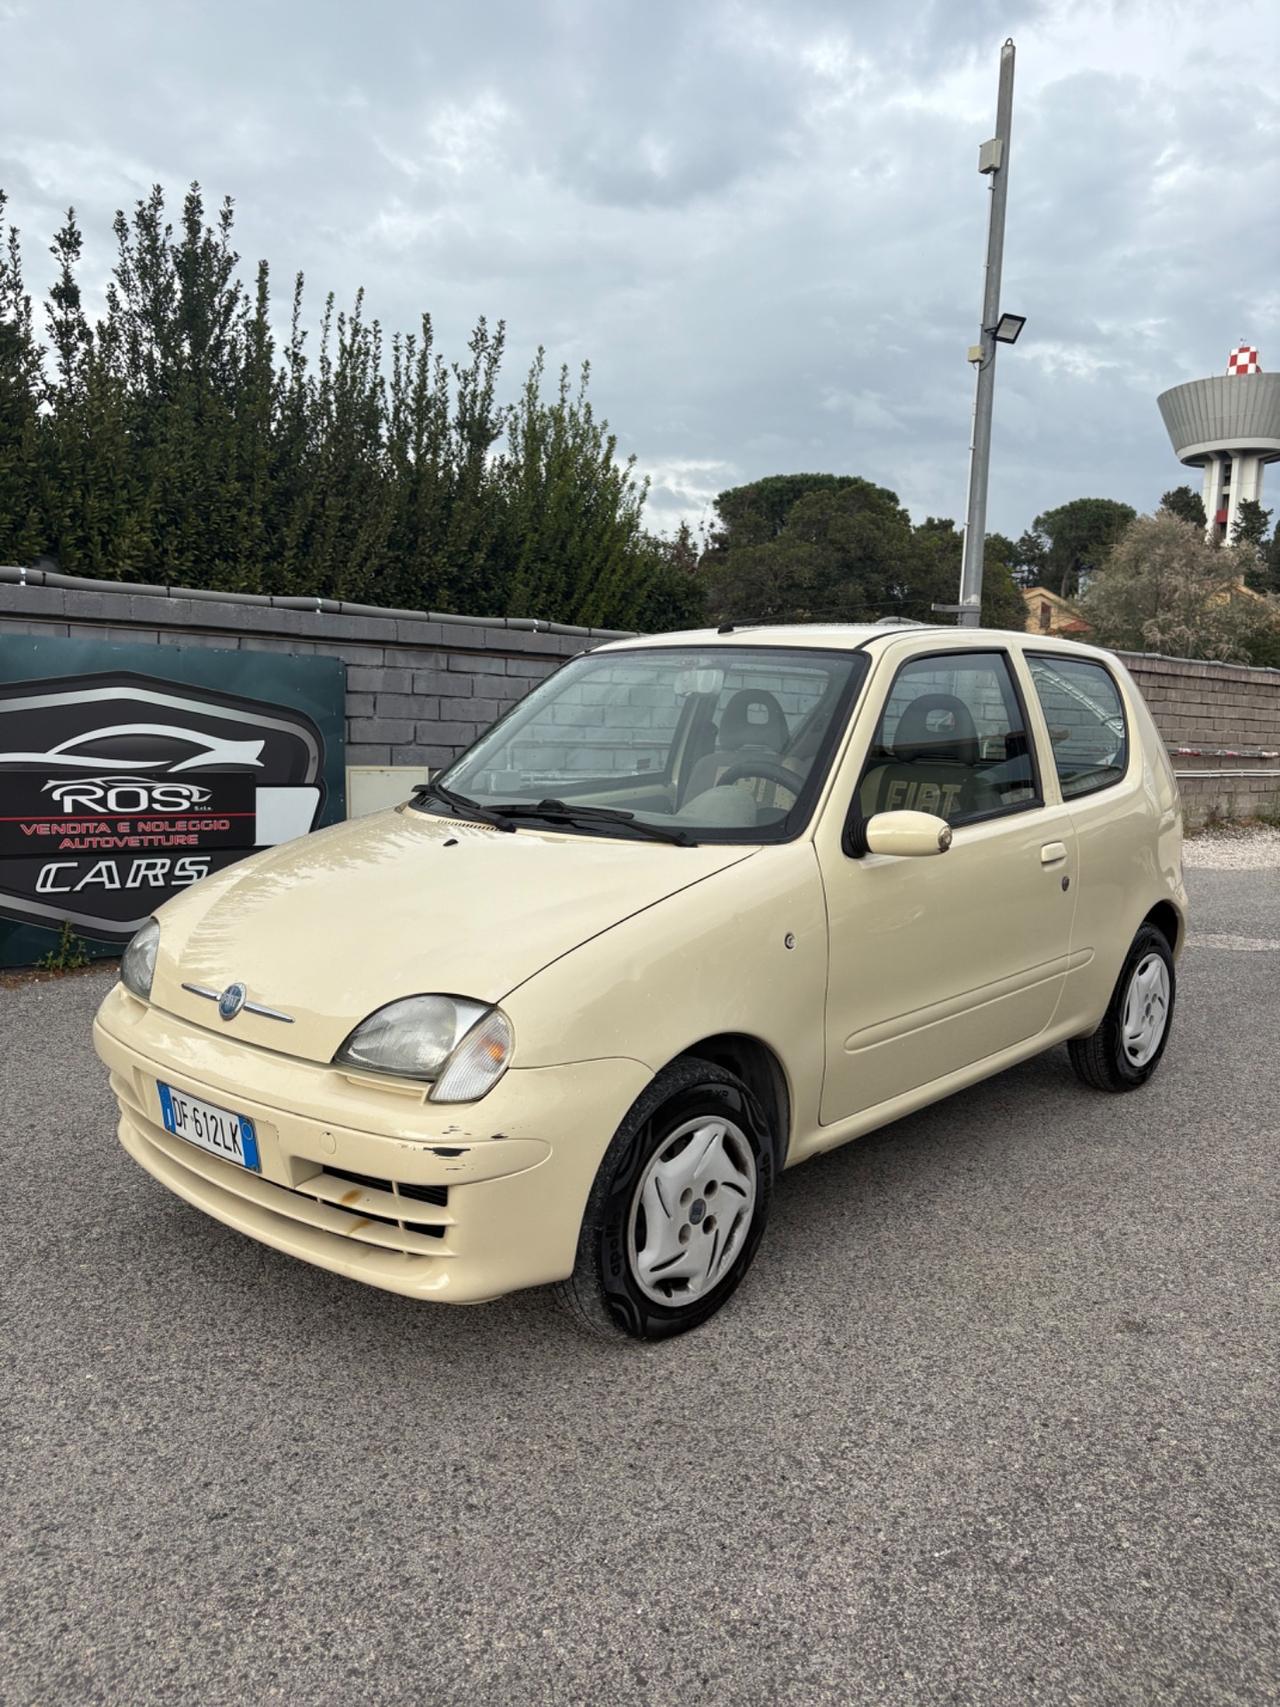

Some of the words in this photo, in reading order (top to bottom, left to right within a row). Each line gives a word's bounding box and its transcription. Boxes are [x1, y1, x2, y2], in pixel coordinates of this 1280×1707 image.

[52, 785, 192, 813] ROS
[884, 780, 963, 820] FIAT
[20, 821, 111, 836] VENDITA
[117, 821, 131, 834] E
[137, 819, 230, 833] NOLEGGIO
[59, 834, 199, 849] AUTOVETTURE
[35, 856, 212, 893] CARS
[172, 1096, 188, 1130] DF
[193, 1106, 242, 1156] 612LK
